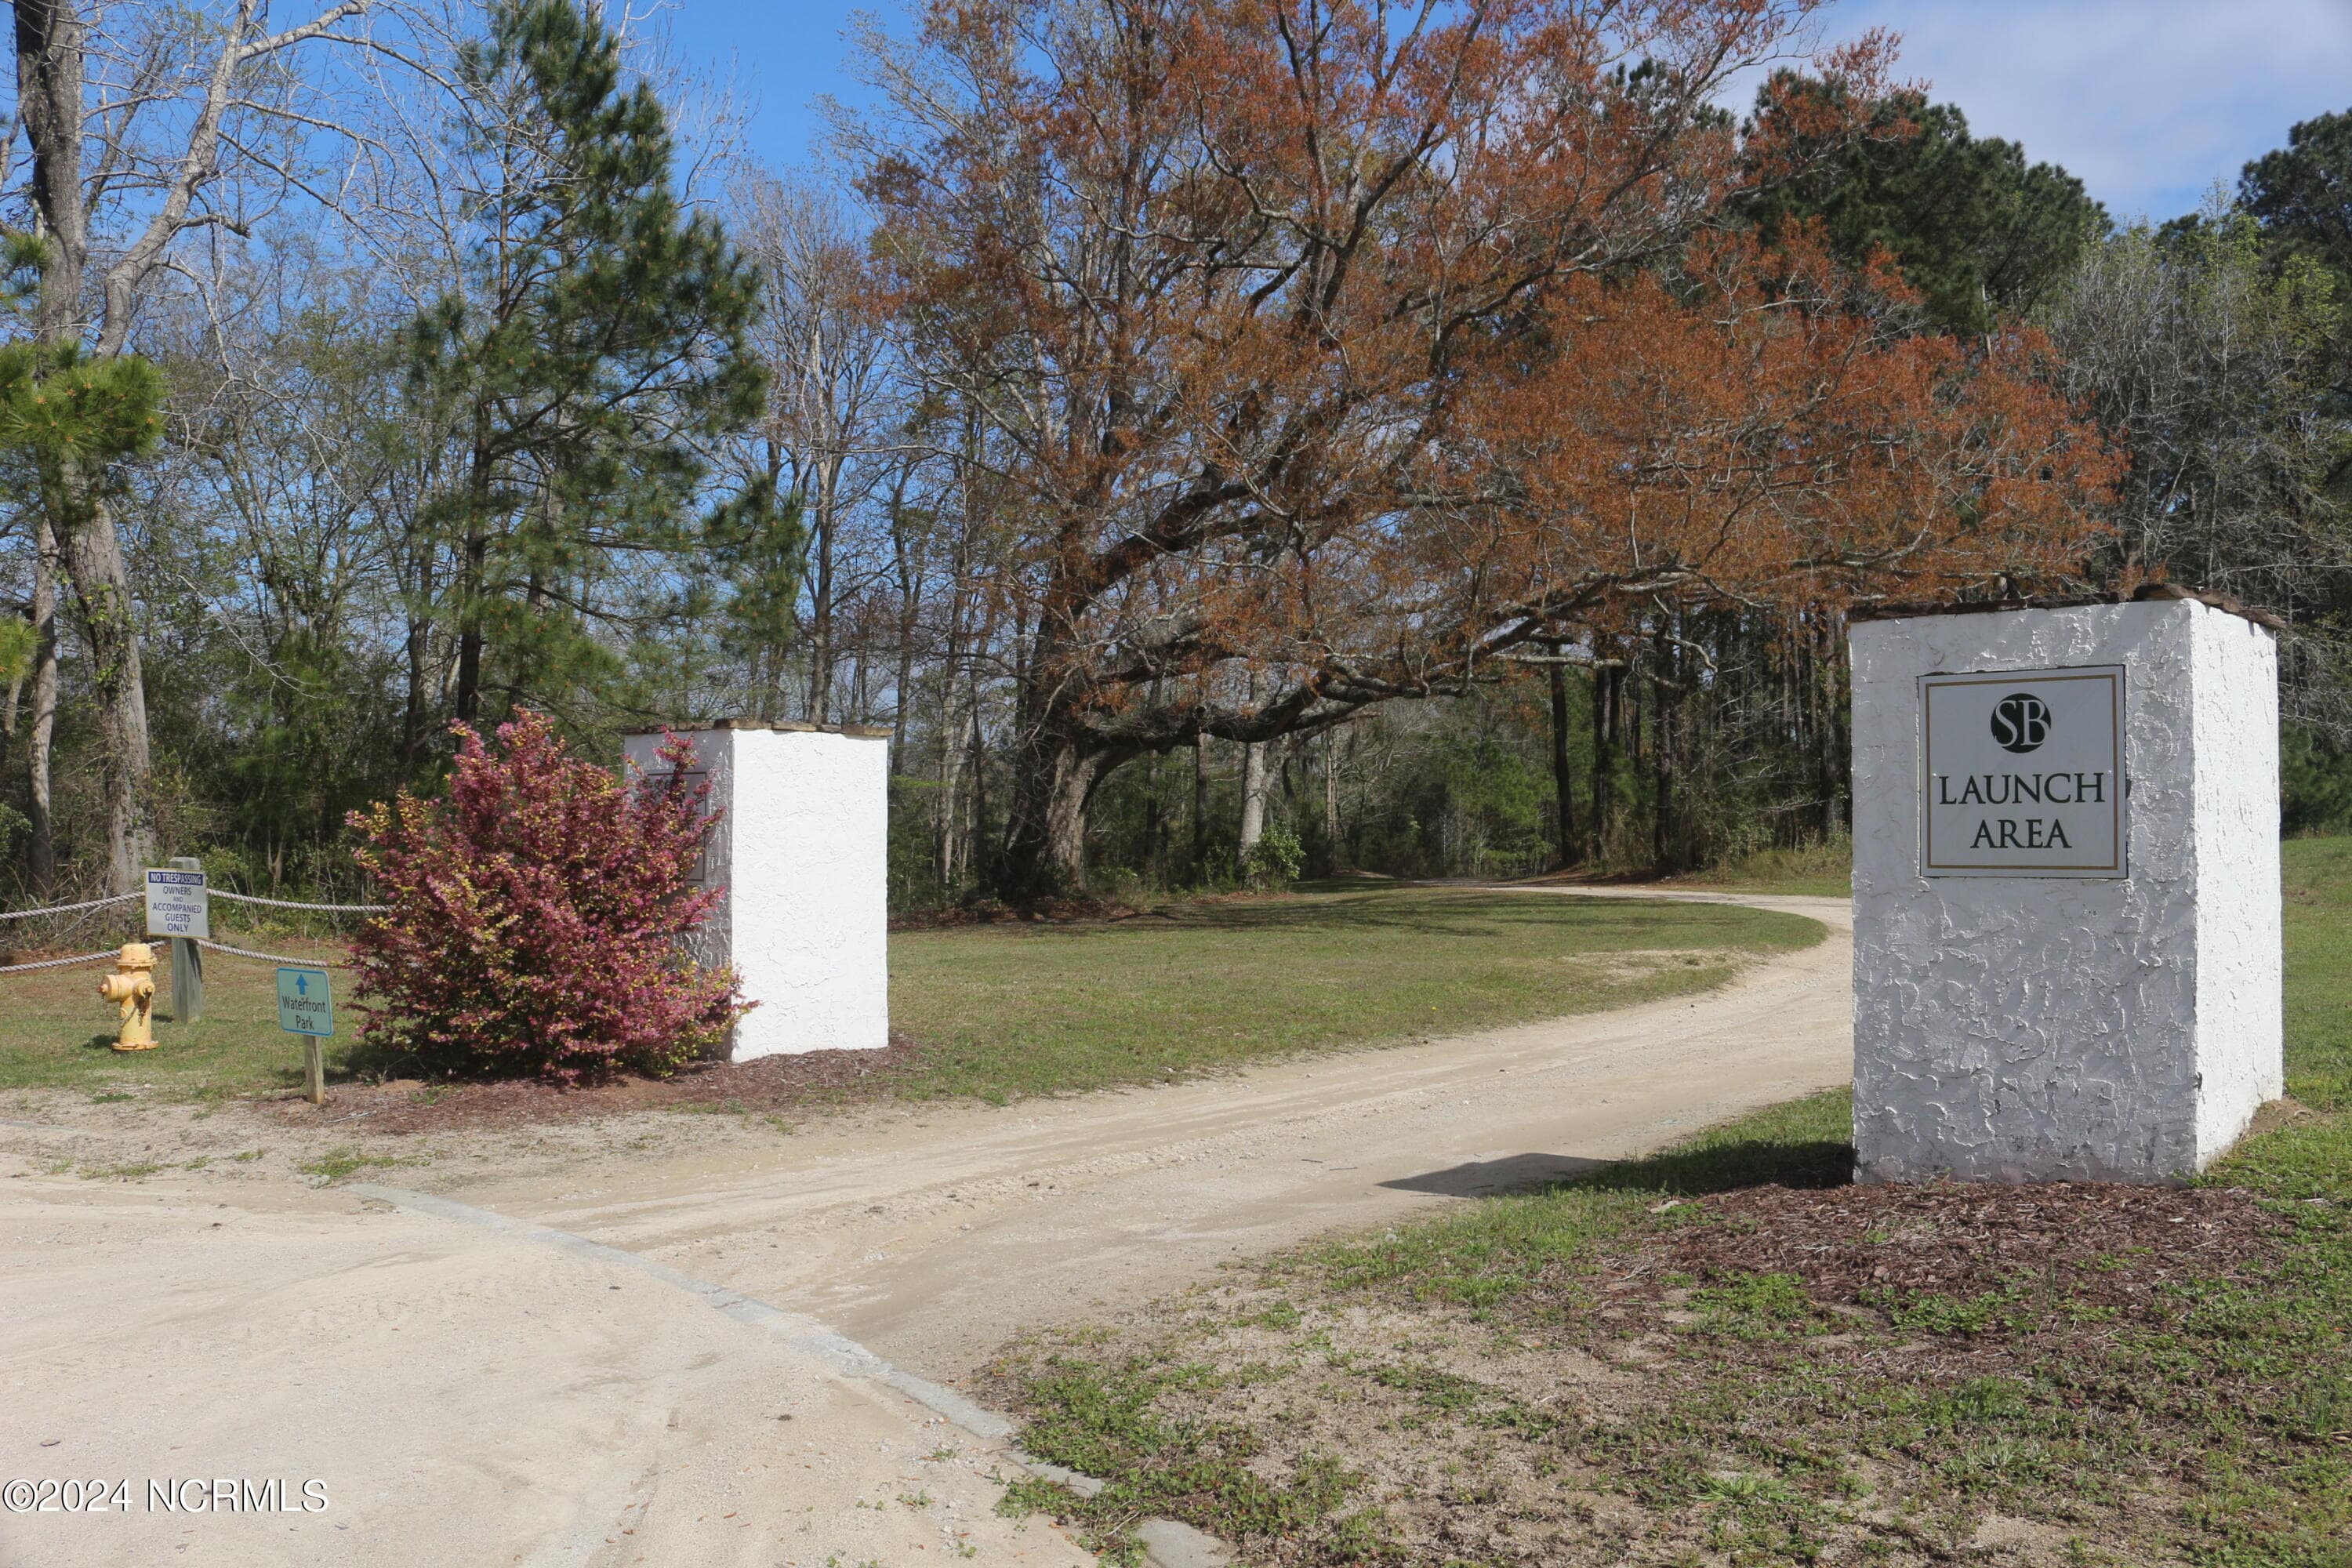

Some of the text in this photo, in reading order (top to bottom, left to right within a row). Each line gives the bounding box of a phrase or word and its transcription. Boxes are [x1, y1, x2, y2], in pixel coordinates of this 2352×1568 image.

[1939, 772, 2105, 804] LAUNCH
[1970, 818, 2072, 848] AREA
[151, 873, 201, 884] NO TRESPASSING
[163, 886, 192, 895] OWNERS
[153, 903, 201, 913] ACCOMPANIED
[165, 913, 191, 923] GUESTS
[167, 923, 189, 932] ONLY
[282, 996, 326, 1013] Waterfront
[296, 1015, 314, 1029] Park
